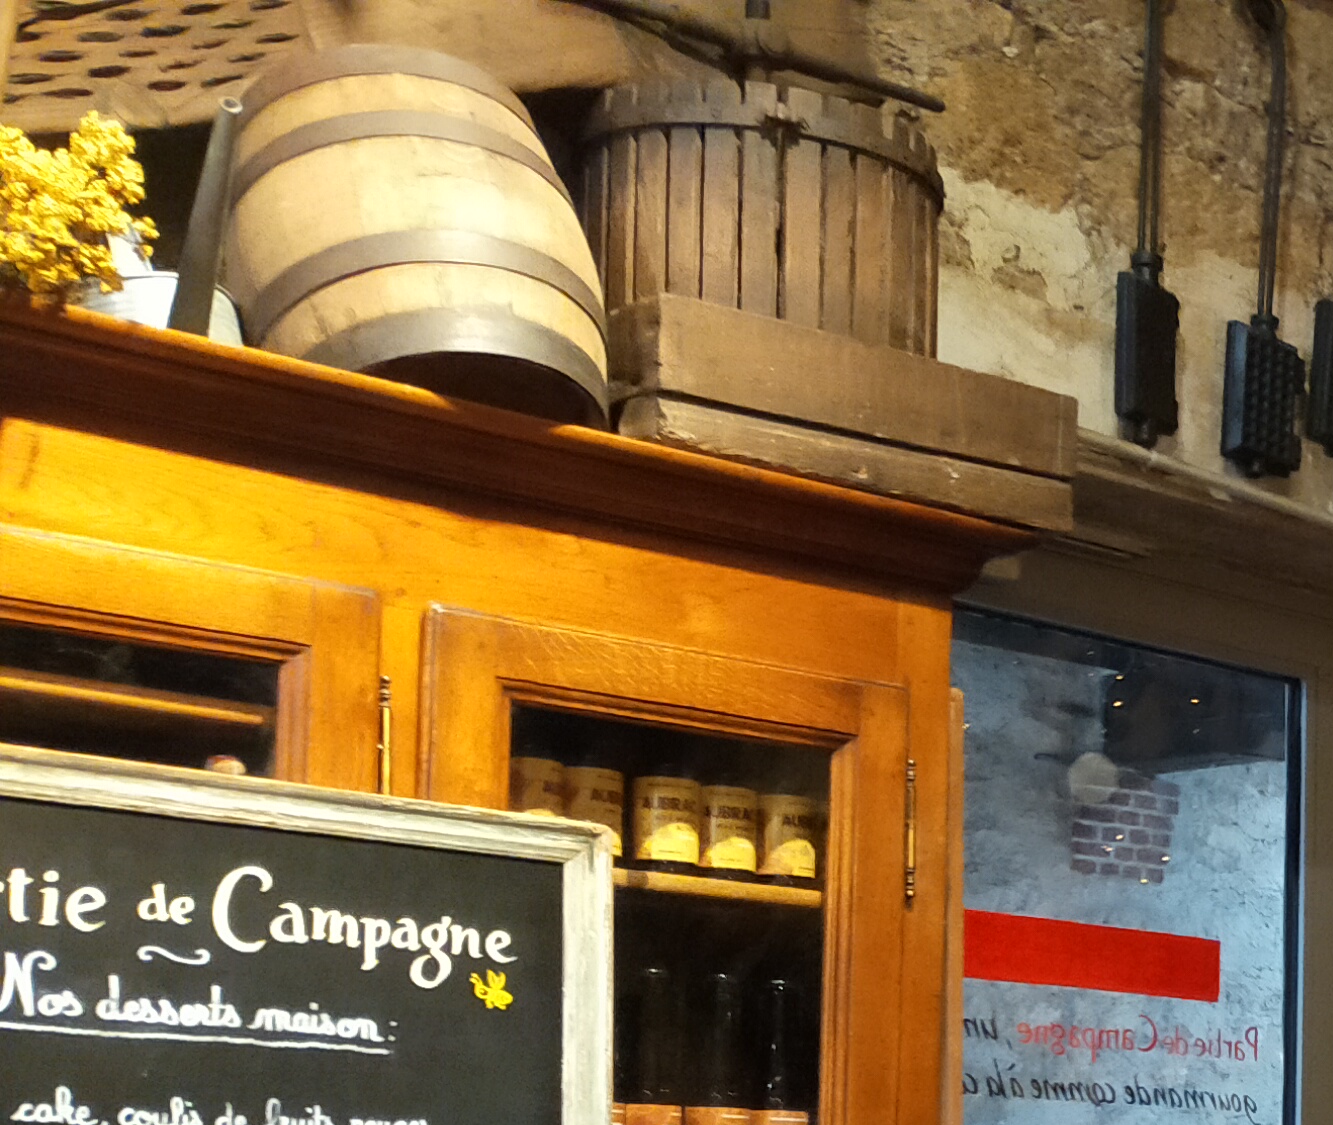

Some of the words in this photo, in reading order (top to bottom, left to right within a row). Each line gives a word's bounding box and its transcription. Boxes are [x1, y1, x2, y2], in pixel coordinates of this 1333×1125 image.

[0, 868, 106, 932] tie
[137, 883, 195, 925] de
[211, 865, 518, 990] Campagne
[0, 950, 84, 1017] Nos
[95, 975, 241, 1027] desserts
